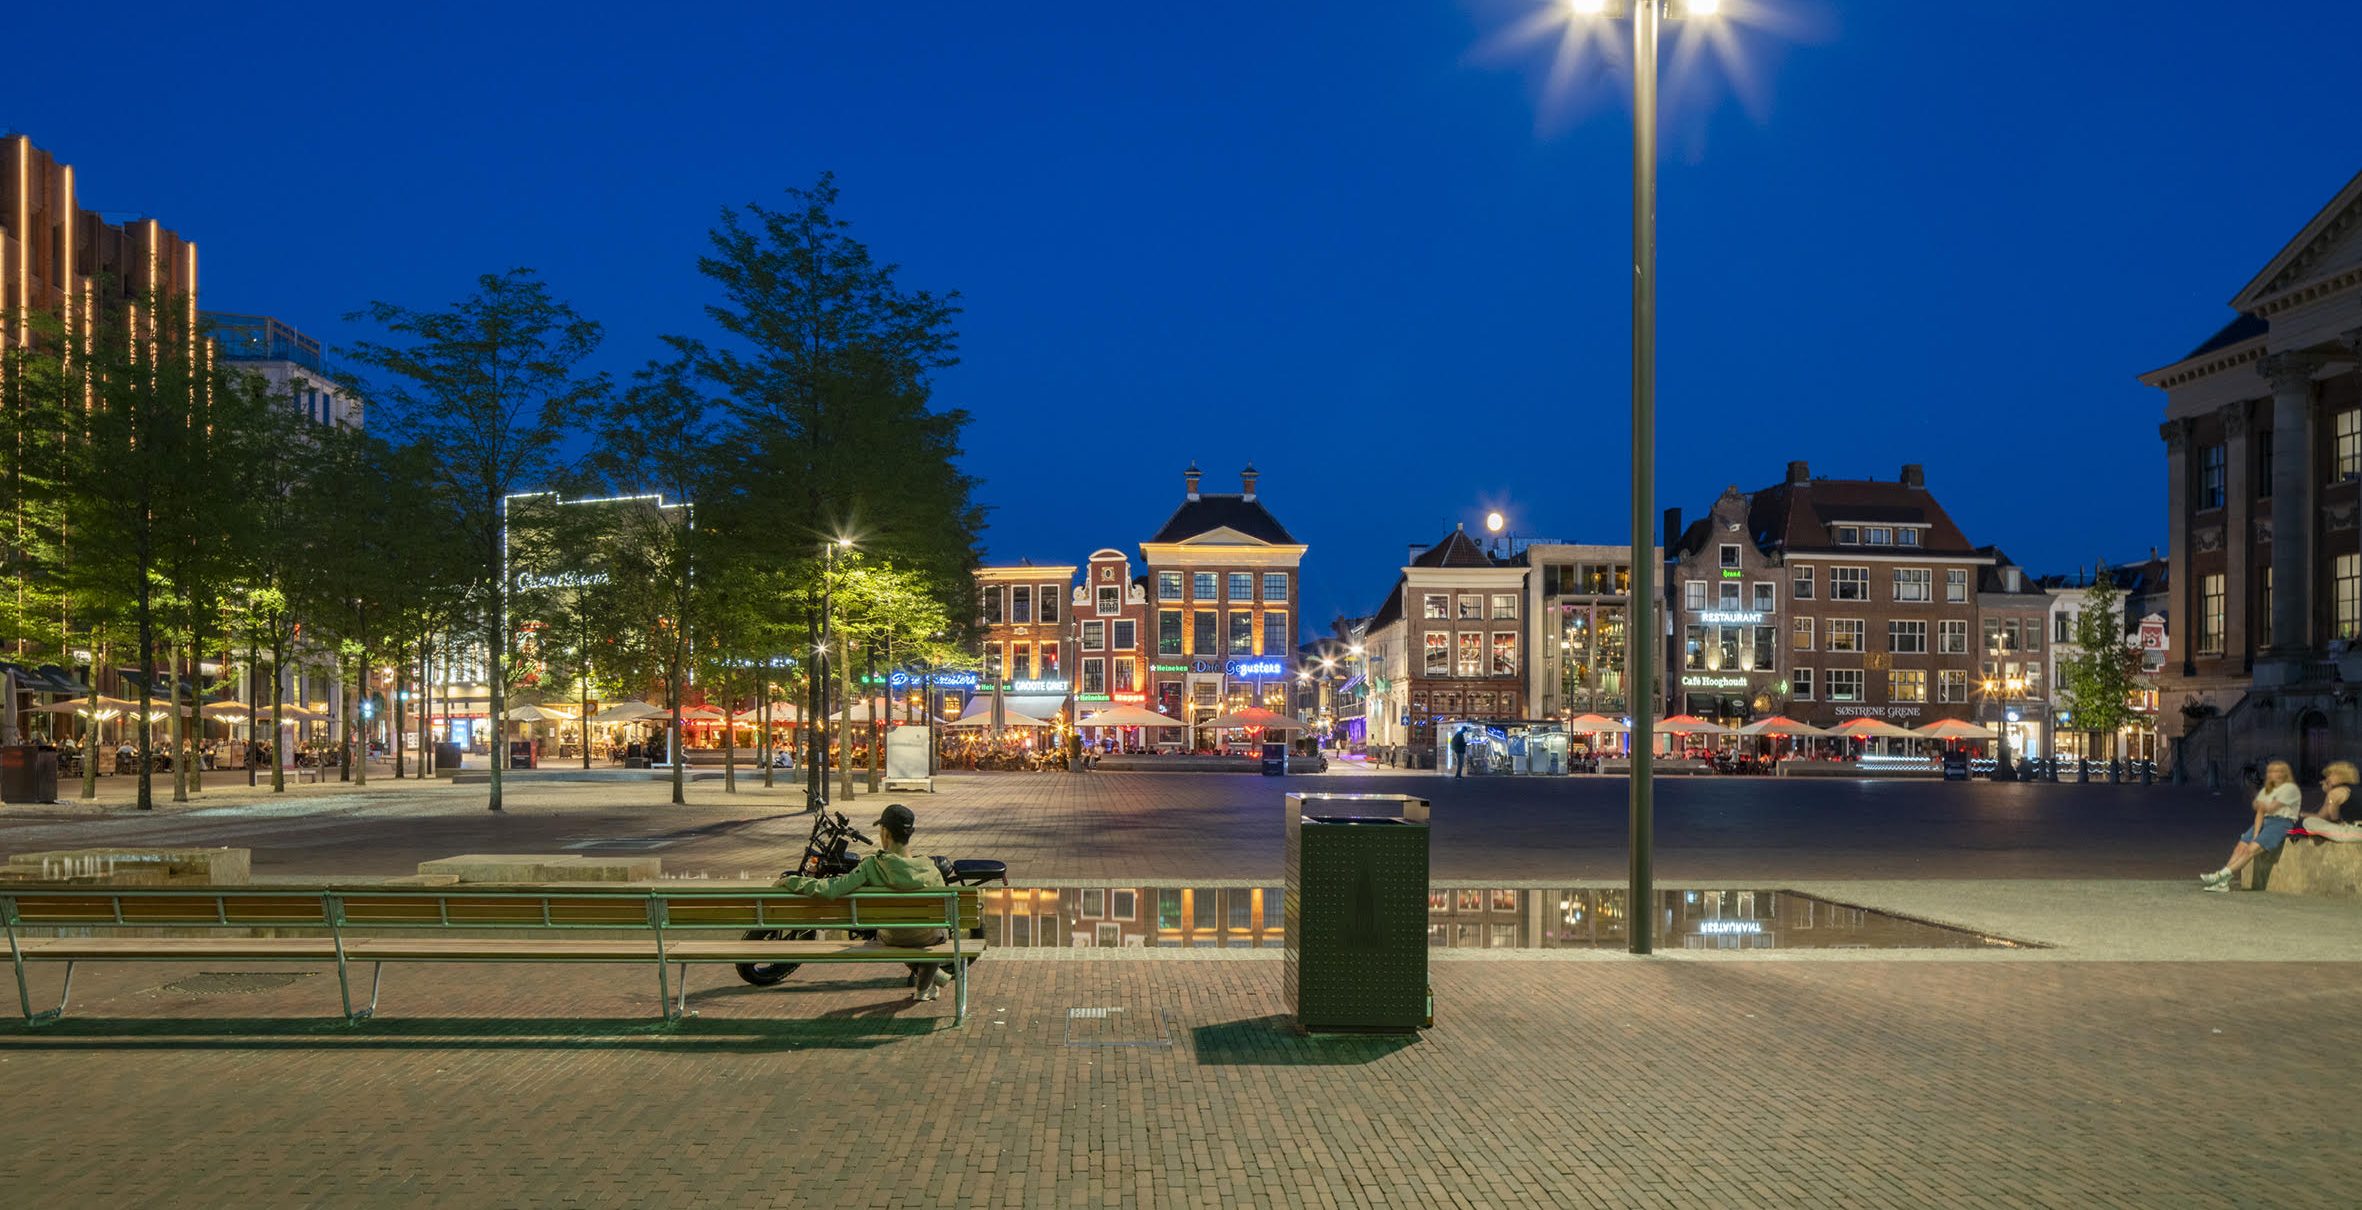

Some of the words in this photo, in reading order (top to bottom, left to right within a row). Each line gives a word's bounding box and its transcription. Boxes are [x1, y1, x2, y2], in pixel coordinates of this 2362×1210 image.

[1701, 612, 1762, 622] RESTAURANT
[1156, 664, 1189, 672] Heineken
[1015, 681, 1046, 691] GROOTE
[1046, 681, 1069, 691] GRIET
[1682, 676, 1701, 686] Café
[1702, 677, 1748, 688] Hooghoudt
[1079, 693, 1110, 701] Heineken
[1835, 706, 1886, 717] SØSTRENE
[1887, 706, 1921, 718] GRENE
